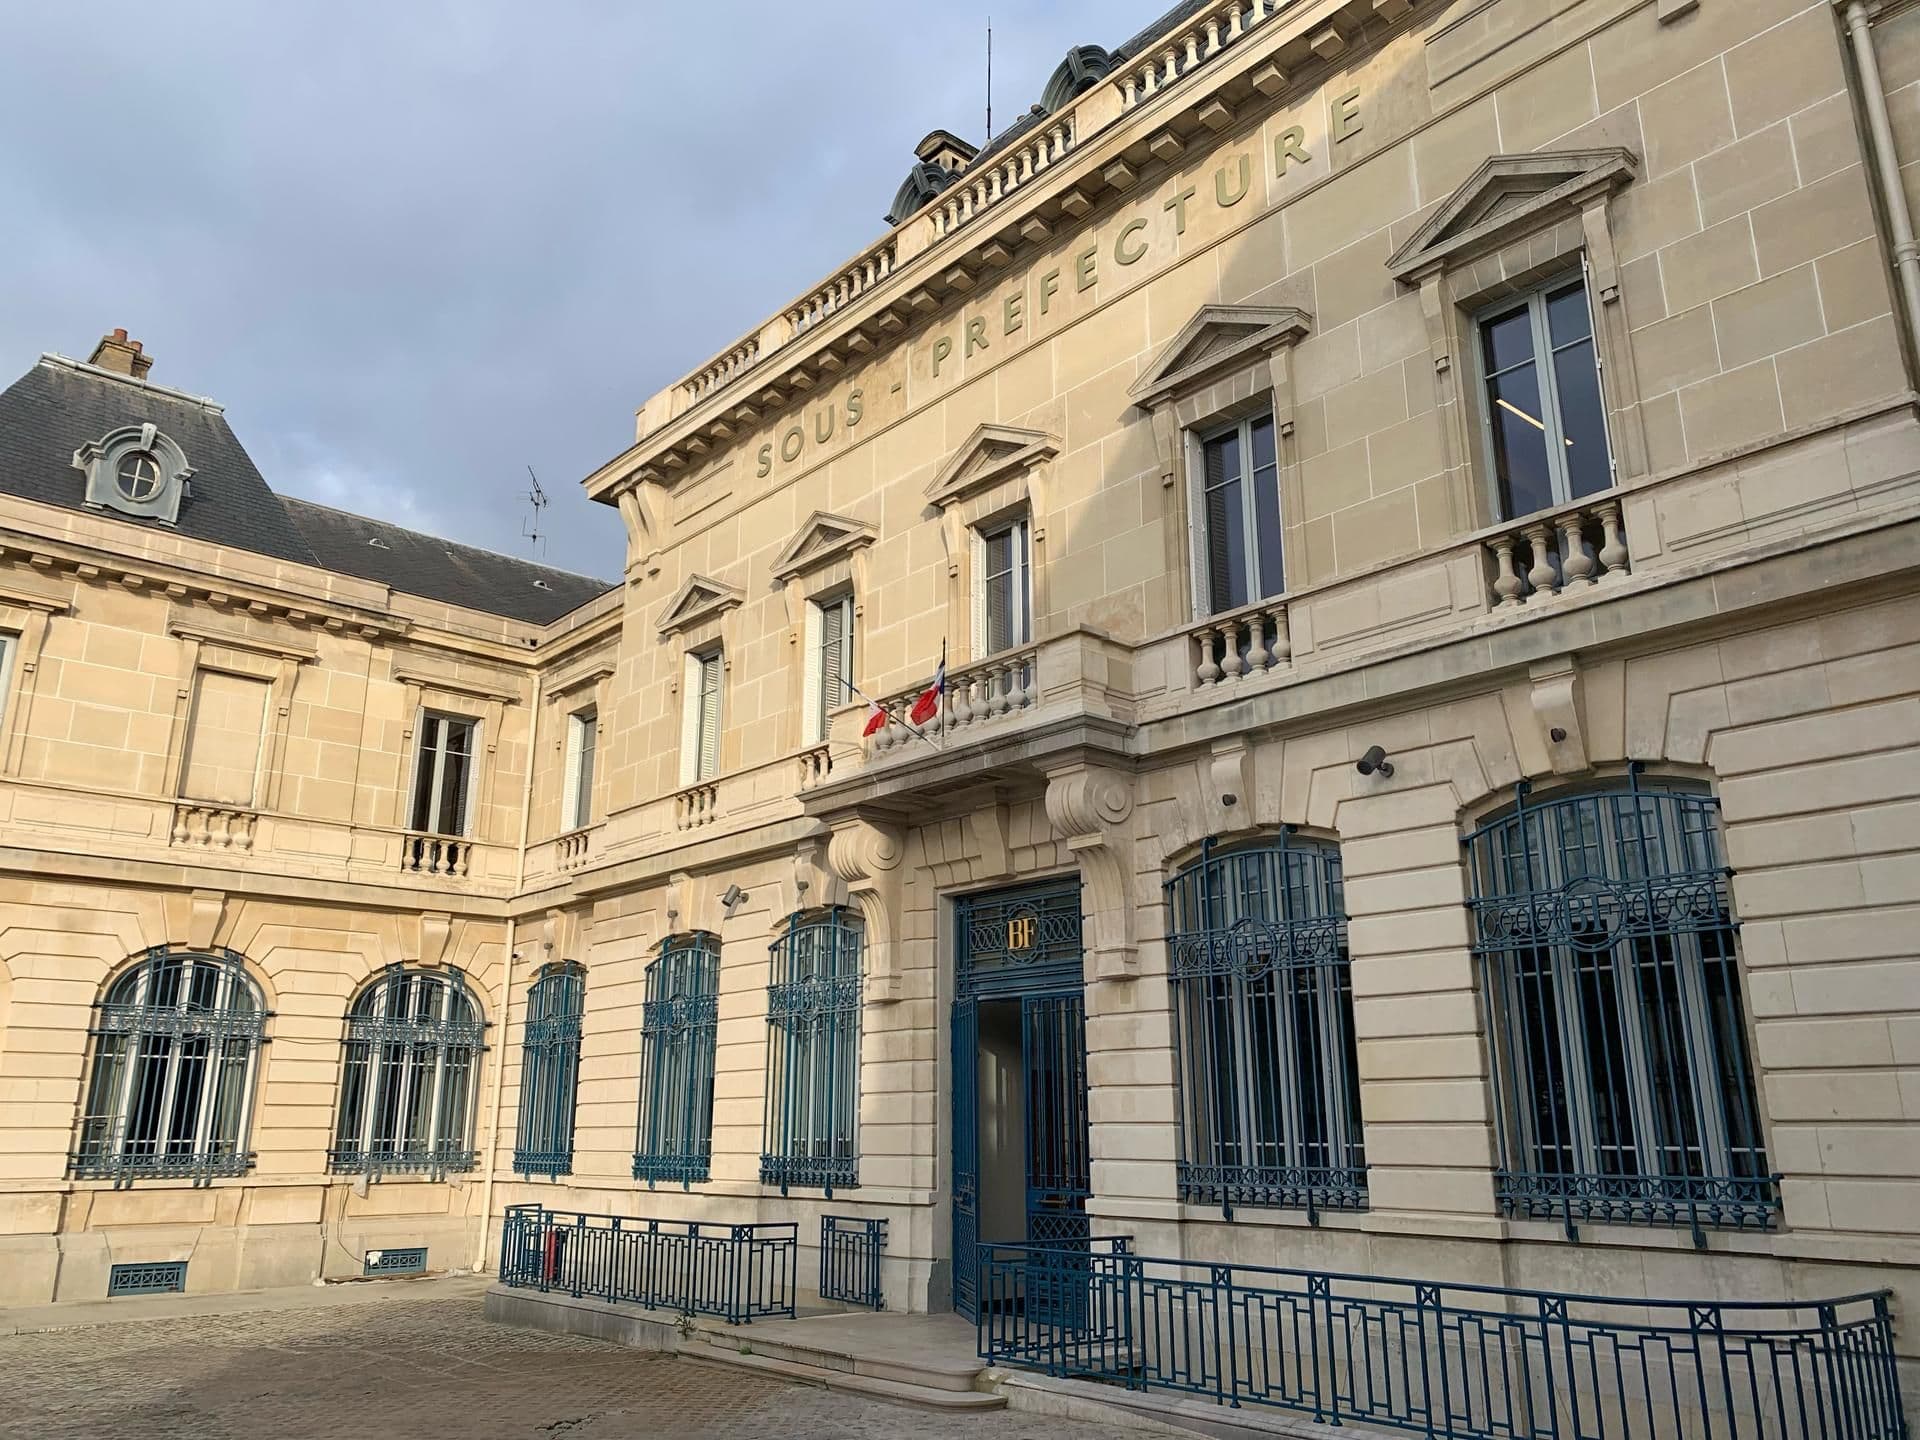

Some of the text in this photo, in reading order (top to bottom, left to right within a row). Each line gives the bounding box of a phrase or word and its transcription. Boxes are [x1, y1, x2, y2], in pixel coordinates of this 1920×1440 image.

[757, 387, 864, 479] SOUS
[932, 86, 1365, 379] PREFECTURE
[1007, 917, 1038, 950] BF
